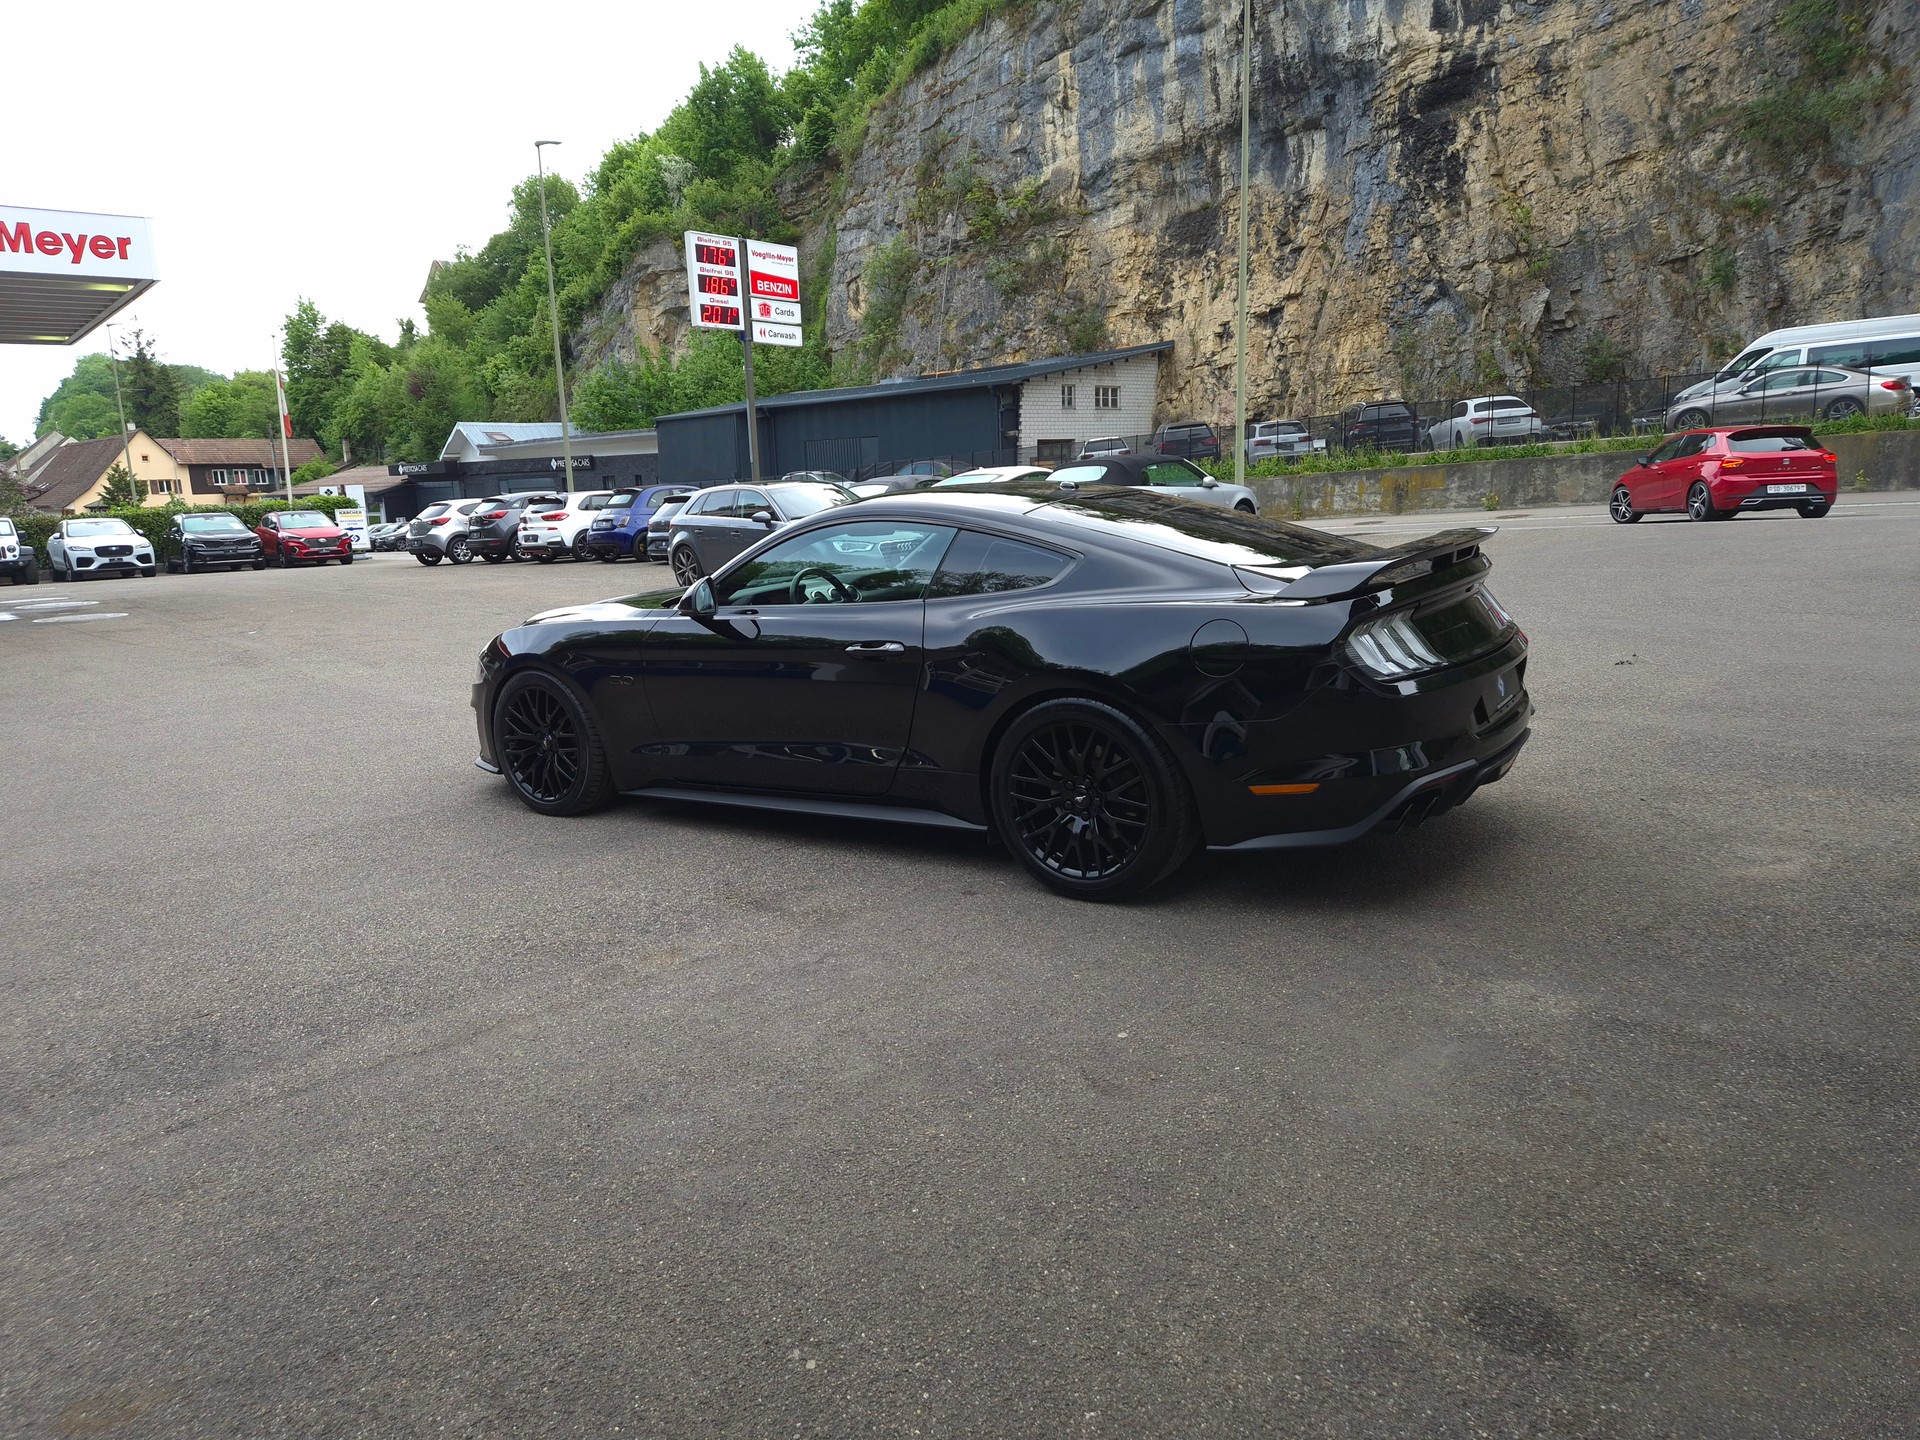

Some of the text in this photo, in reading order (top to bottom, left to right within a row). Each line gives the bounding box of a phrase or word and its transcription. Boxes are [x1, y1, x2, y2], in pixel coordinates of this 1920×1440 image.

[0, 220, 132, 264] Meyer
[697, 236, 721, 245] Bleifrei
[751, 250, 794, 262] Voegtlin-Meyer
[700, 266, 723, 275] Bleifrei
[757, 280, 792, 294] BENZIN
[774, 307, 795, 317] Cards
[768, 330, 797, 340] Carwash
[557, 458, 590, 467] PRESA CARS
